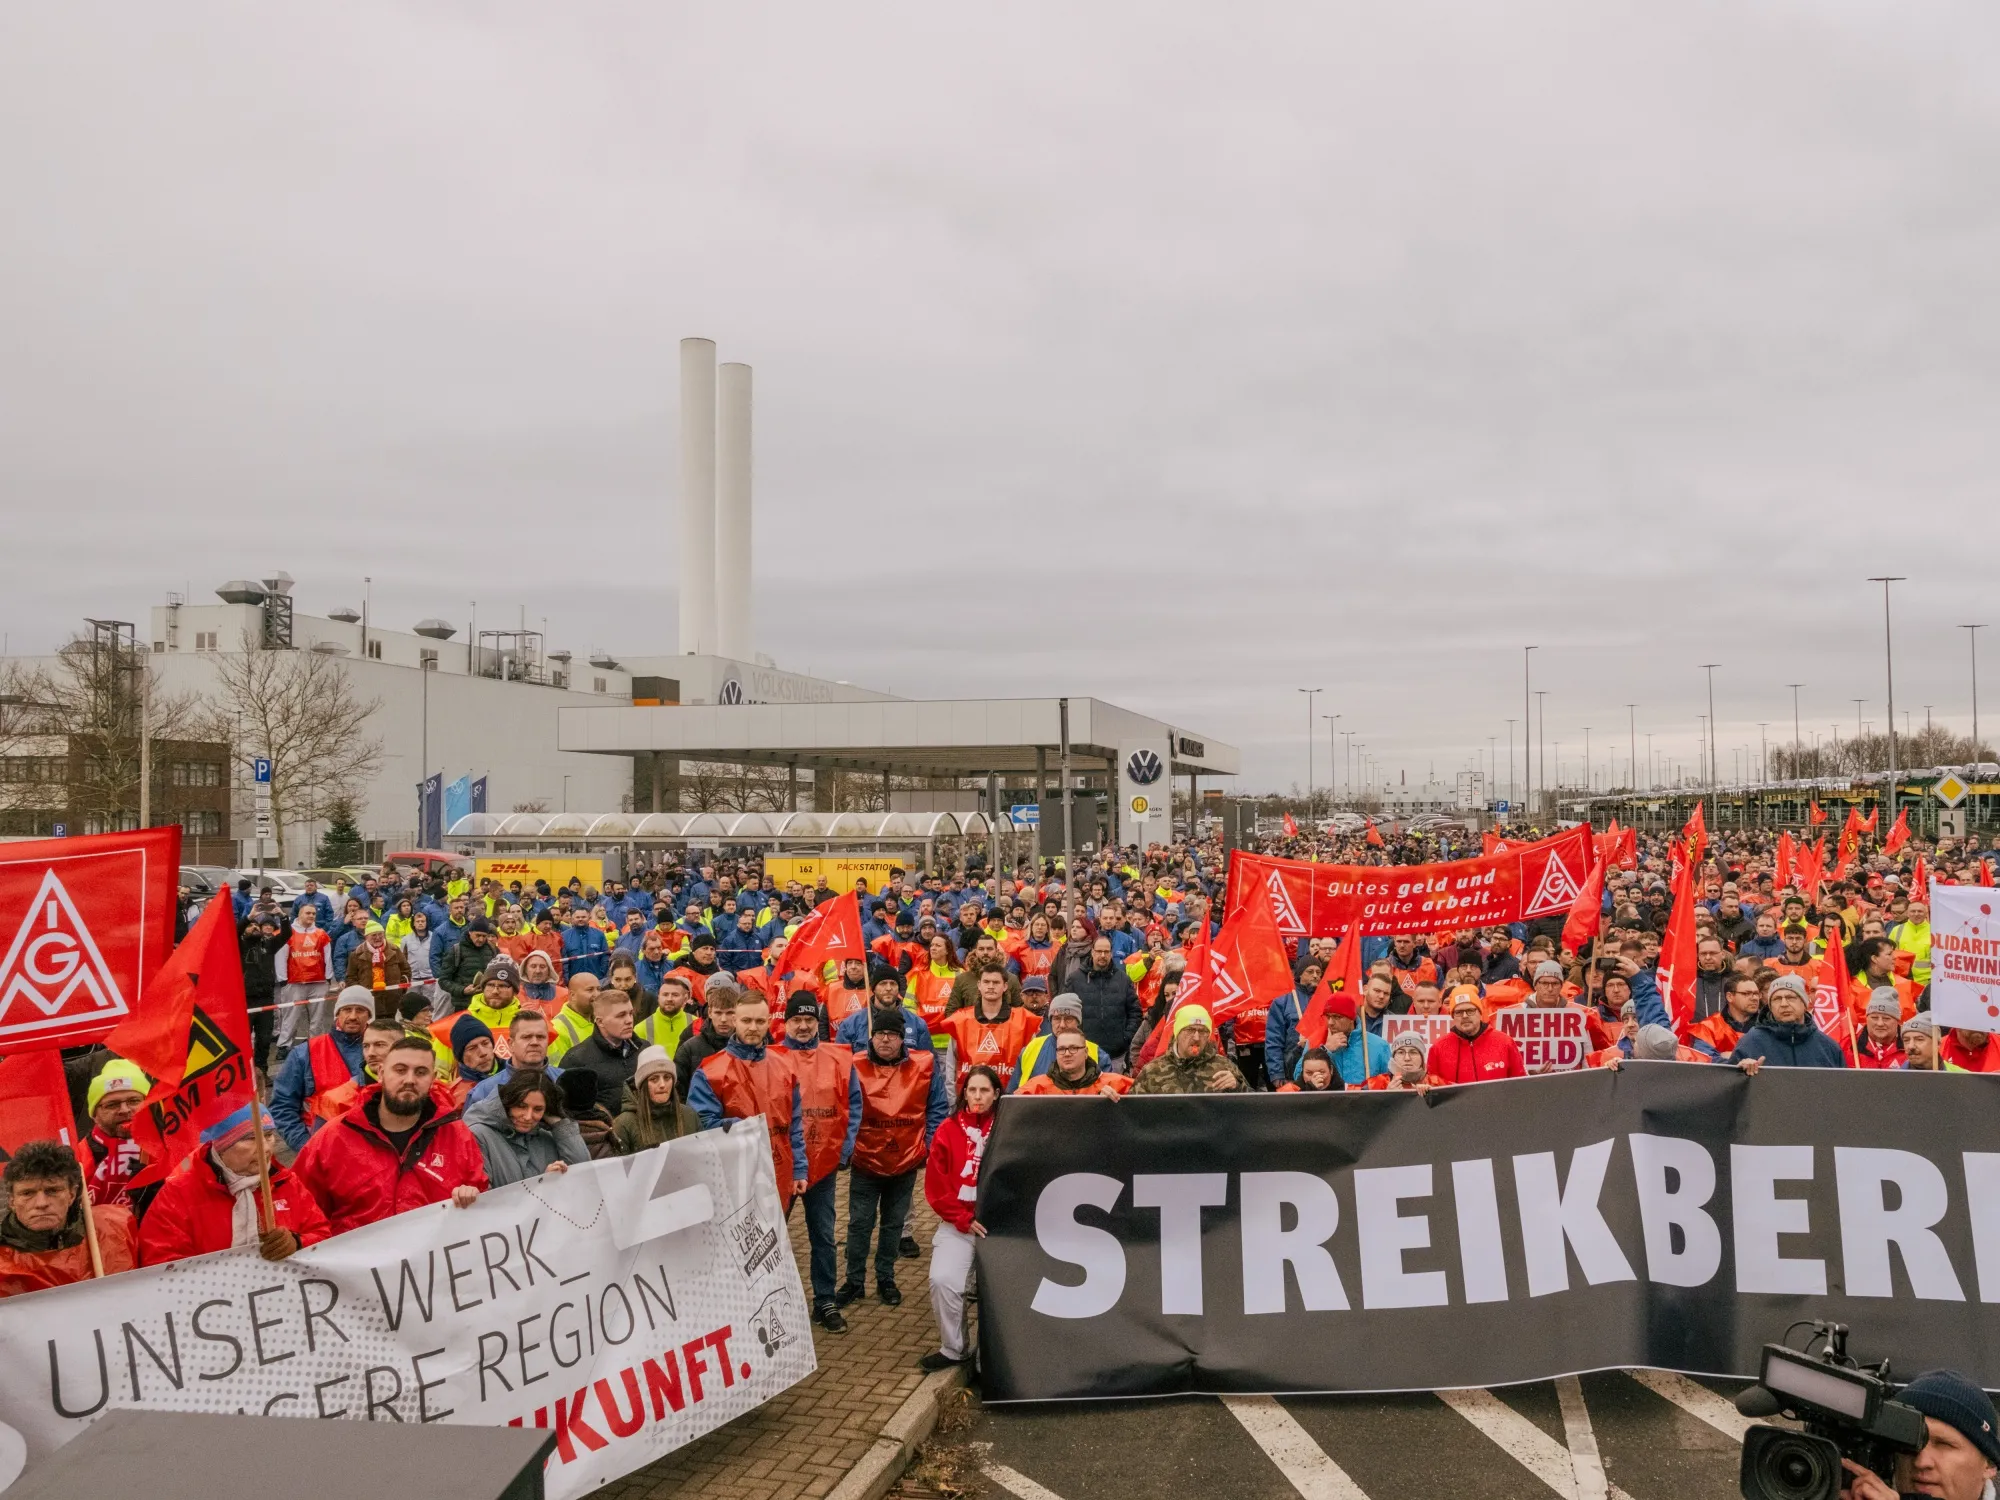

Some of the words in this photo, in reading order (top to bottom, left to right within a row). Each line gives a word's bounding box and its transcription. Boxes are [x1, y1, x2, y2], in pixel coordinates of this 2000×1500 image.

[258, 761, 268, 780] P
[490, 863, 531, 874] DHL
[799, 865, 813, 874] 162
[836, 863, 896, 871] PACKSTATION
[1327, 881, 1389, 897] gutes
[1396, 877, 1448, 899] geld
[1456, 868, 1497, 890] und
[1324, 922, 1364, 933] ...gt
[1369, 921, 1392, 932] für
[1397, 919, 1429, 929] land
[1434, 914, 1459, 926] und
[1464, 909, 1507, 923] leute!
[1364, 902, 1413, 917] gute
[1944, 953, 2000, 976] GEWIN
[1387, 1019, 1449, 1046] MEH
[1501, 1013, 1582, 1038] MEHR
[739, 1223, 765, 1256] LEBEN
[746, 1230, 776, 1274] gestalten
[762, 1247, 783, 1274] WIR!
[478, 1264, 678, 1402] REGION
[47, 1278, 351, 1419] UNSER
[508, 1324, 752, 1465] KUNFT.
